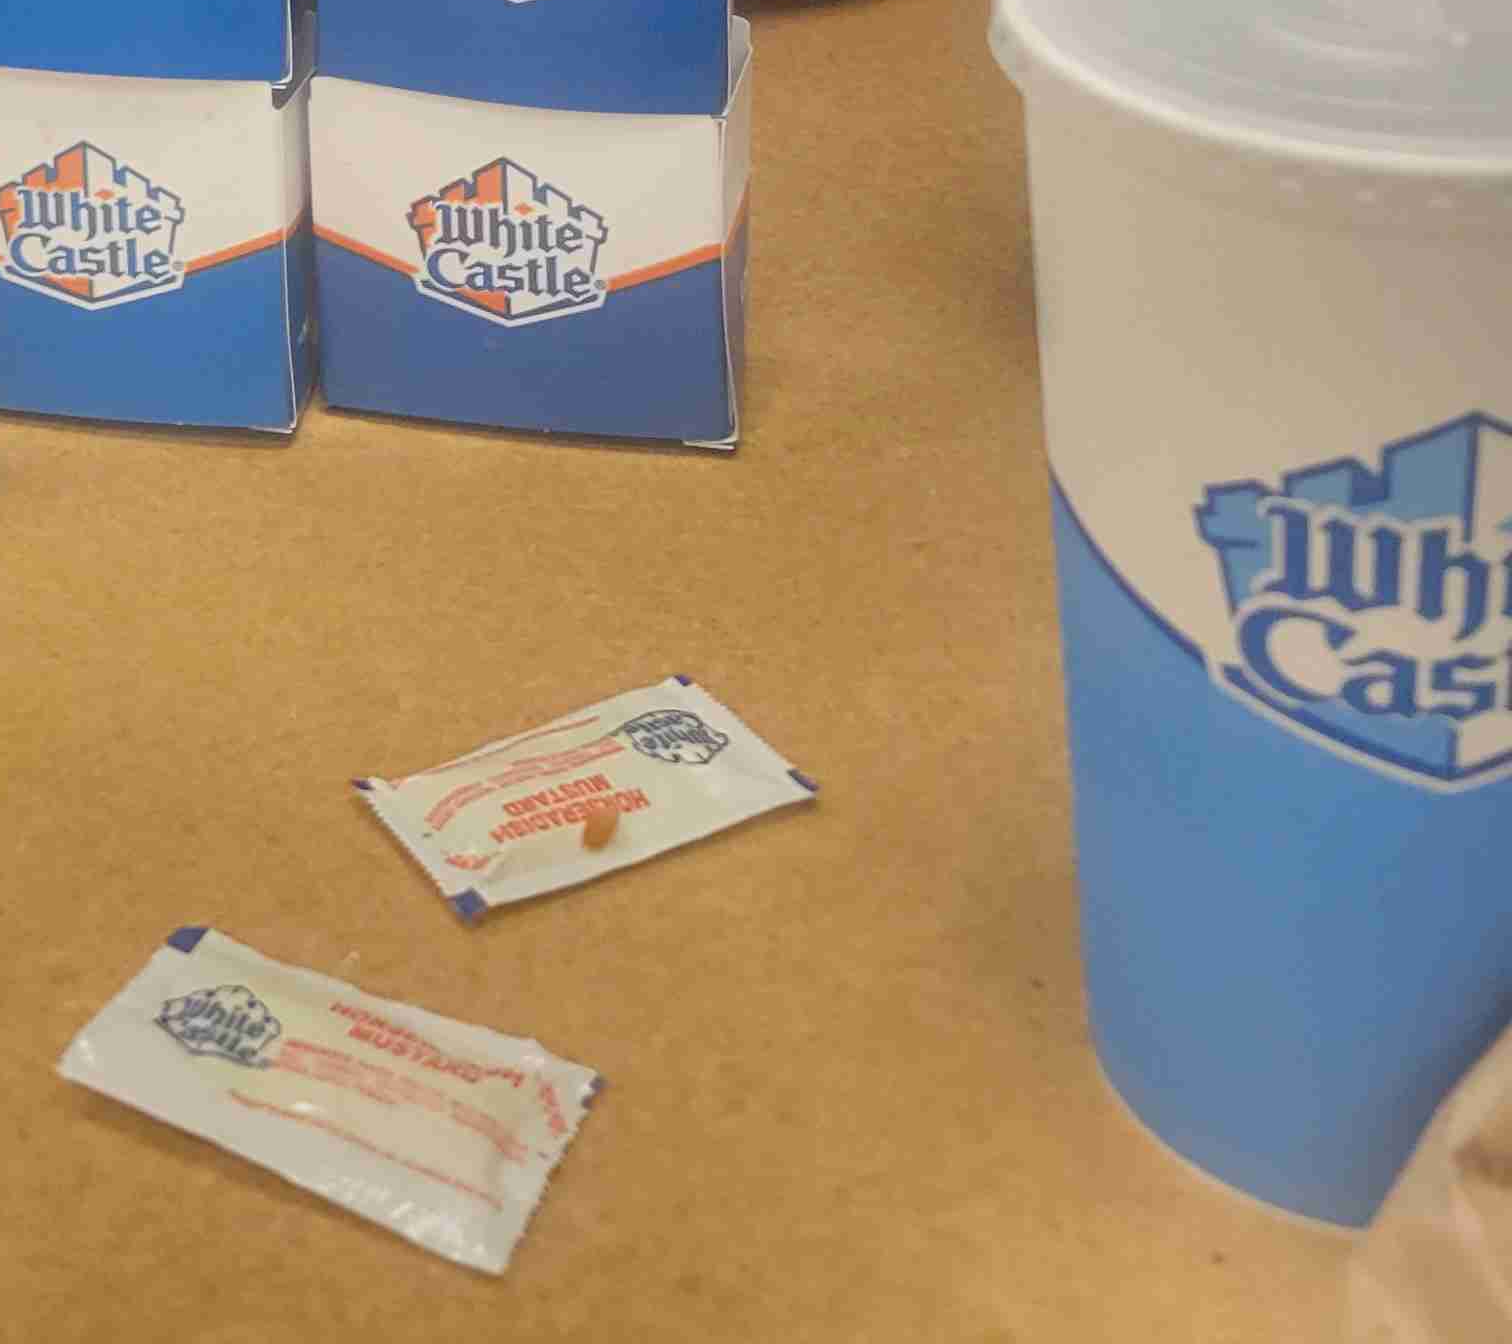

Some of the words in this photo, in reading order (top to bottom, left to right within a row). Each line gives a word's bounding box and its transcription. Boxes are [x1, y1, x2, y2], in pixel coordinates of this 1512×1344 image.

[18, 189, 161, 240] White
[436, 204, 582, 255] White
[9, 233, 170, 279] Castle
[428, 248, 591, 297] Castle
[1262, 506, 1512, 642] Wh
[1238, 606, 1512, 721] Cas
[503, 773, 611, 817] MUSTARD
